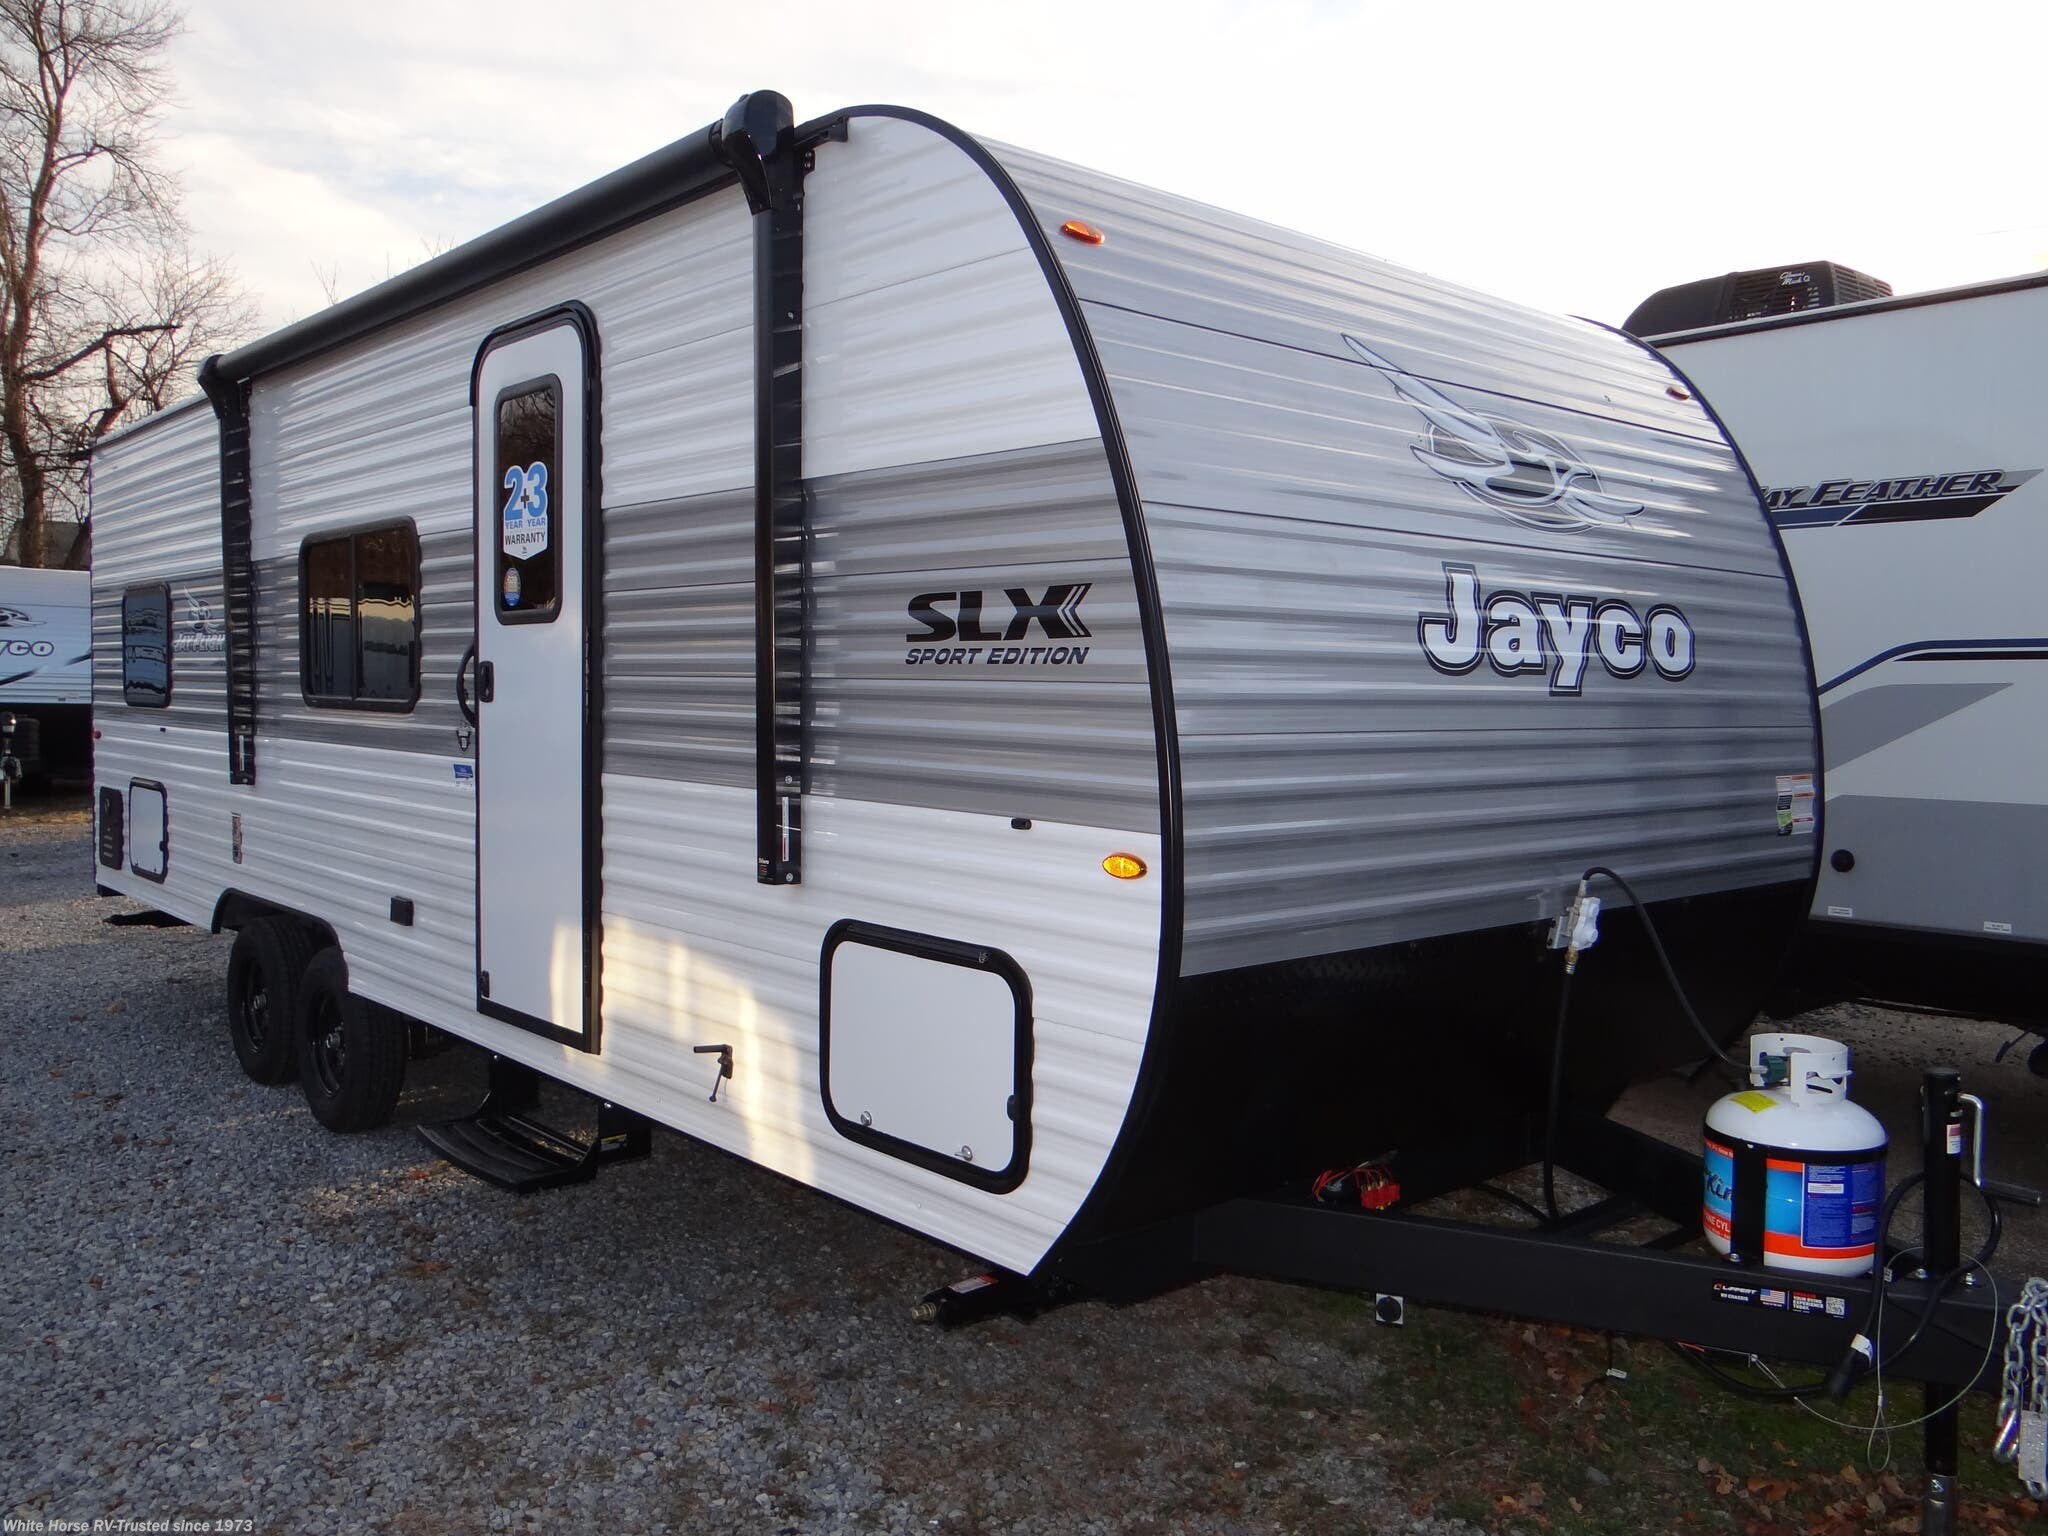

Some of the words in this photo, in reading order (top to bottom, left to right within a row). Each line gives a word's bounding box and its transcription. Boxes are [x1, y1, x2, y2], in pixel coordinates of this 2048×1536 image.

[1807, 469, 2006, 507] FEATHER
[505, 520, 523, 530] YEAR
[527, 518, 546, 528] YEAR
[505, 531, 546, 545] WARRANTY
[906, 583, 1092, 642] SLX
[1417, 561, 1696, 697] Jayco
[193, 632, 226, 652] FLIGH
[905, 647, 983, 665] SPORT
[986, 646, 1089, 665] EDITION
[1721, 1285, 1758, 1295] LIPPERT
